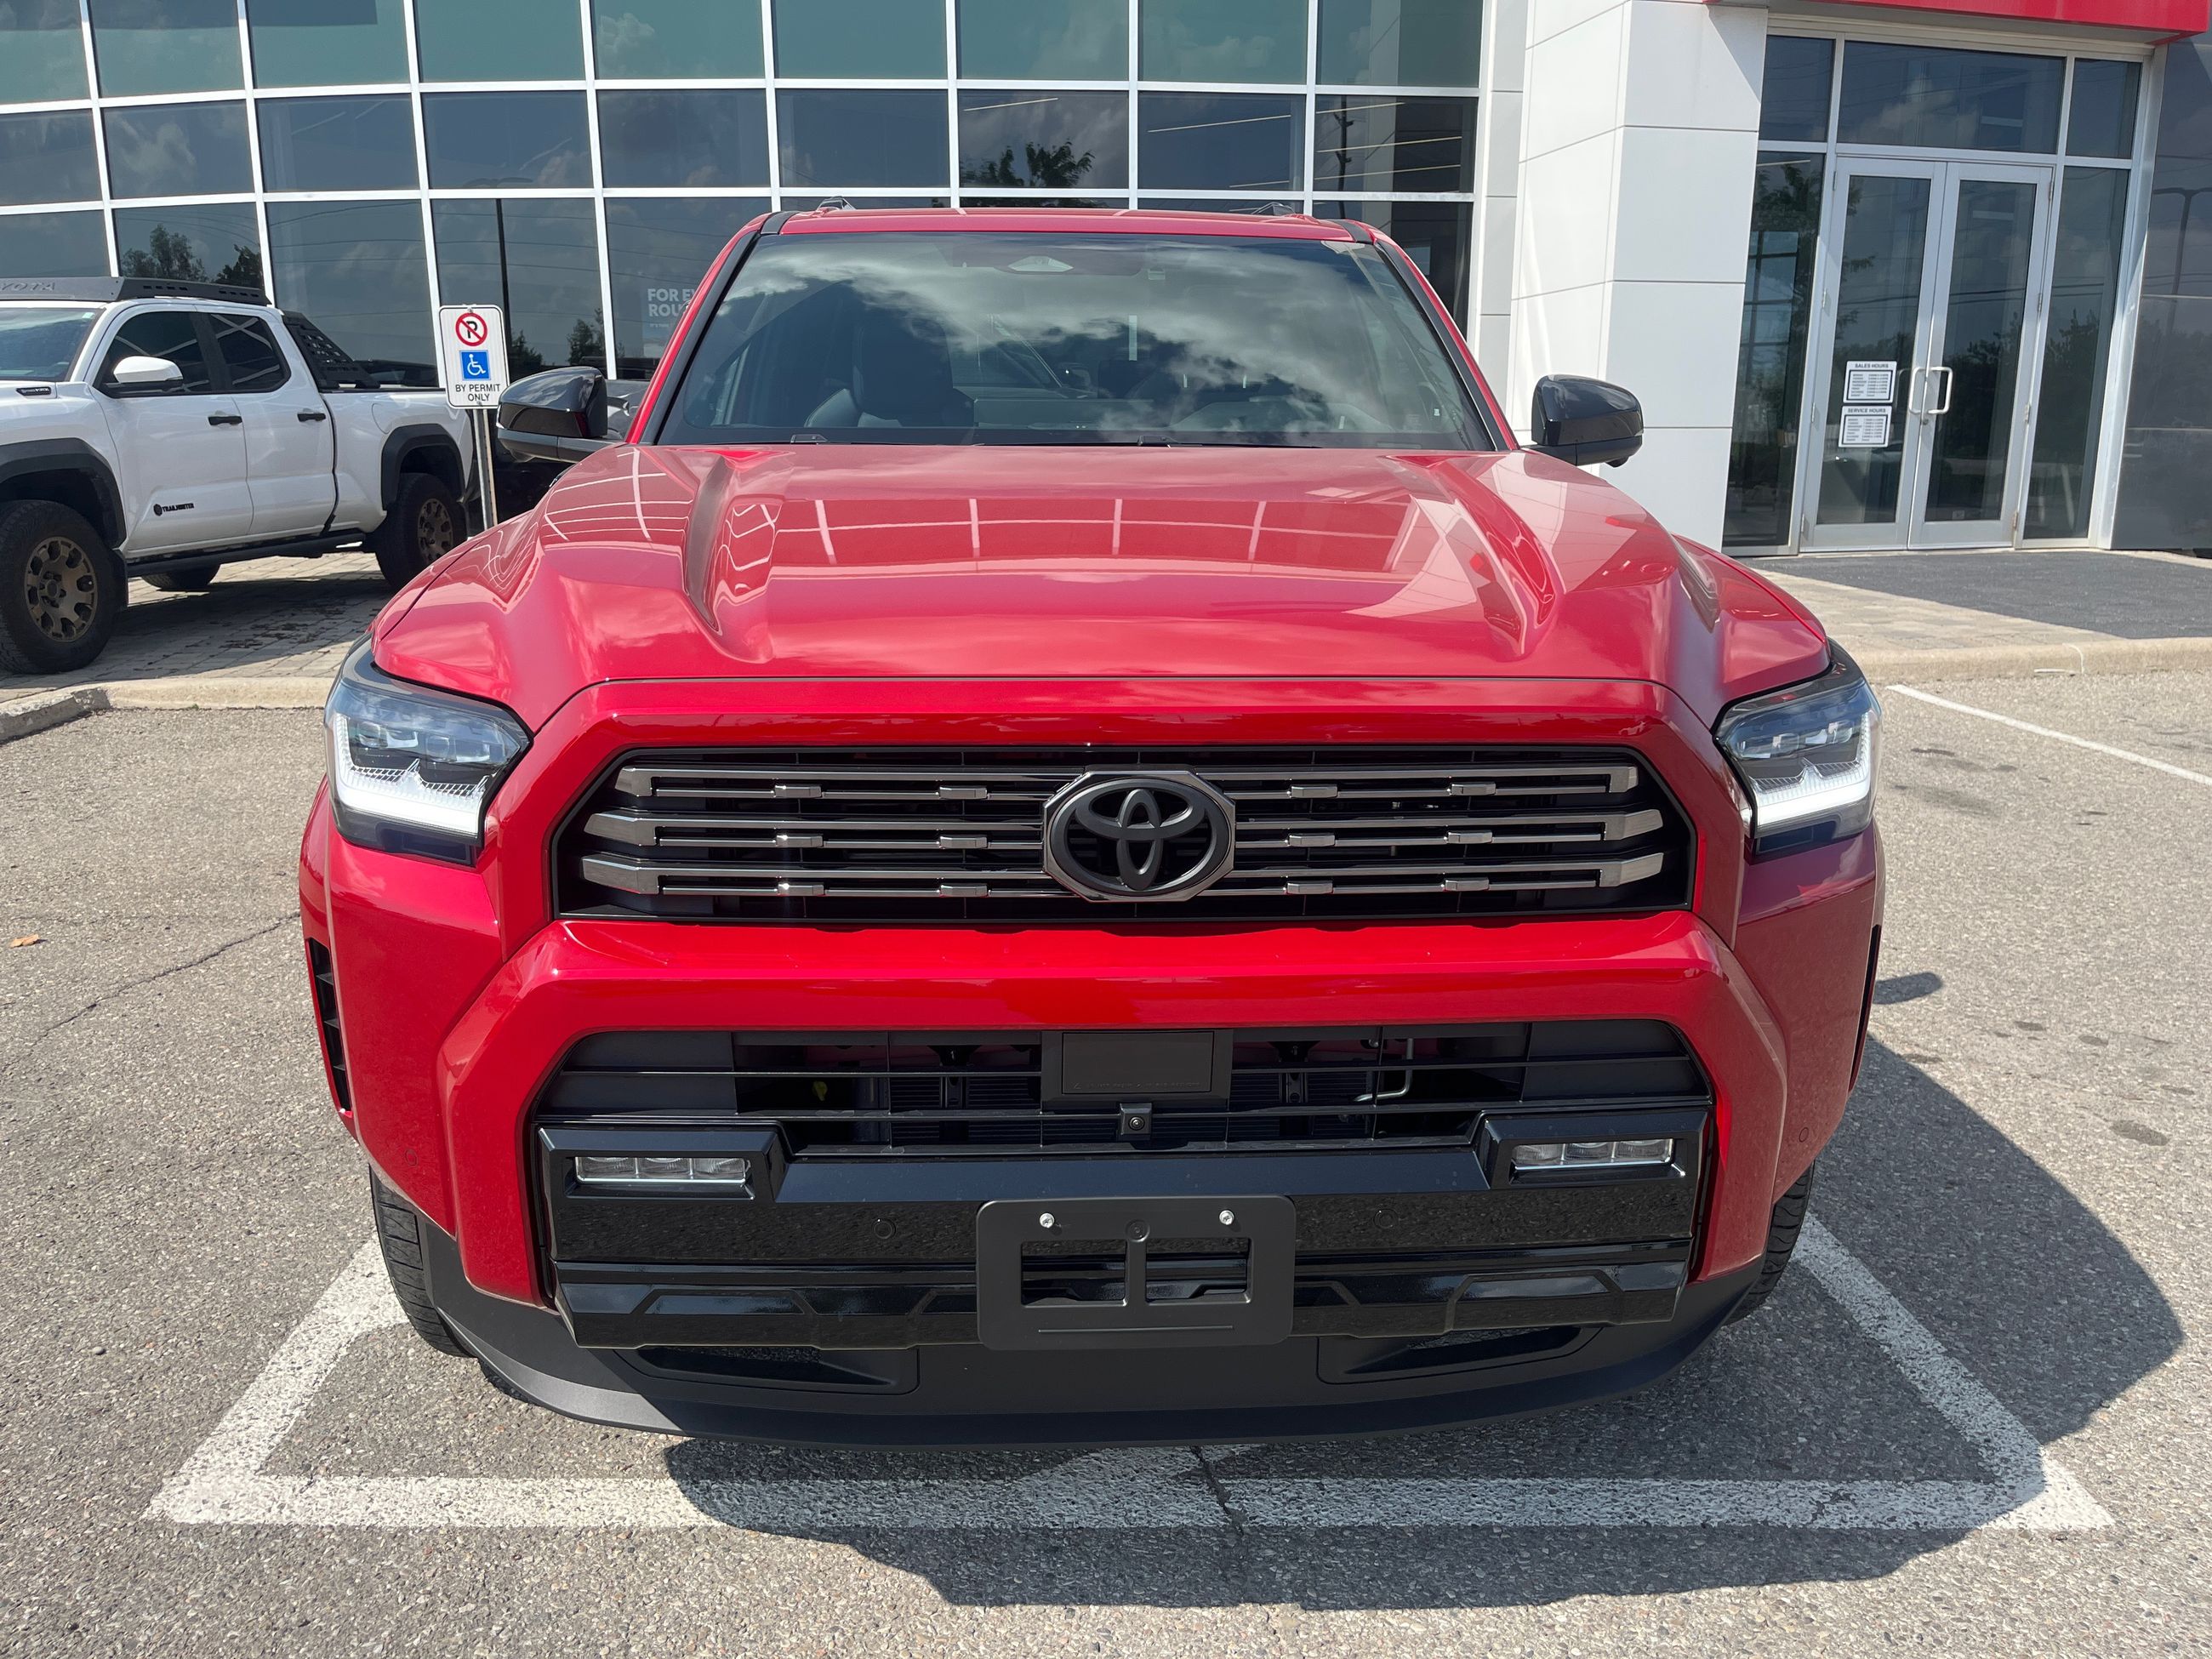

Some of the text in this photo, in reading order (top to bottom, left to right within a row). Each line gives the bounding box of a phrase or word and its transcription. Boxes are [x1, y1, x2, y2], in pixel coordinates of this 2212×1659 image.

[648, 288, 679, 301] FOR
[455, 384, 500, 392] BY PERMIT
[468, 393, 490, 402] ONLY
[162, 503, 194, 512] TRAILTER
